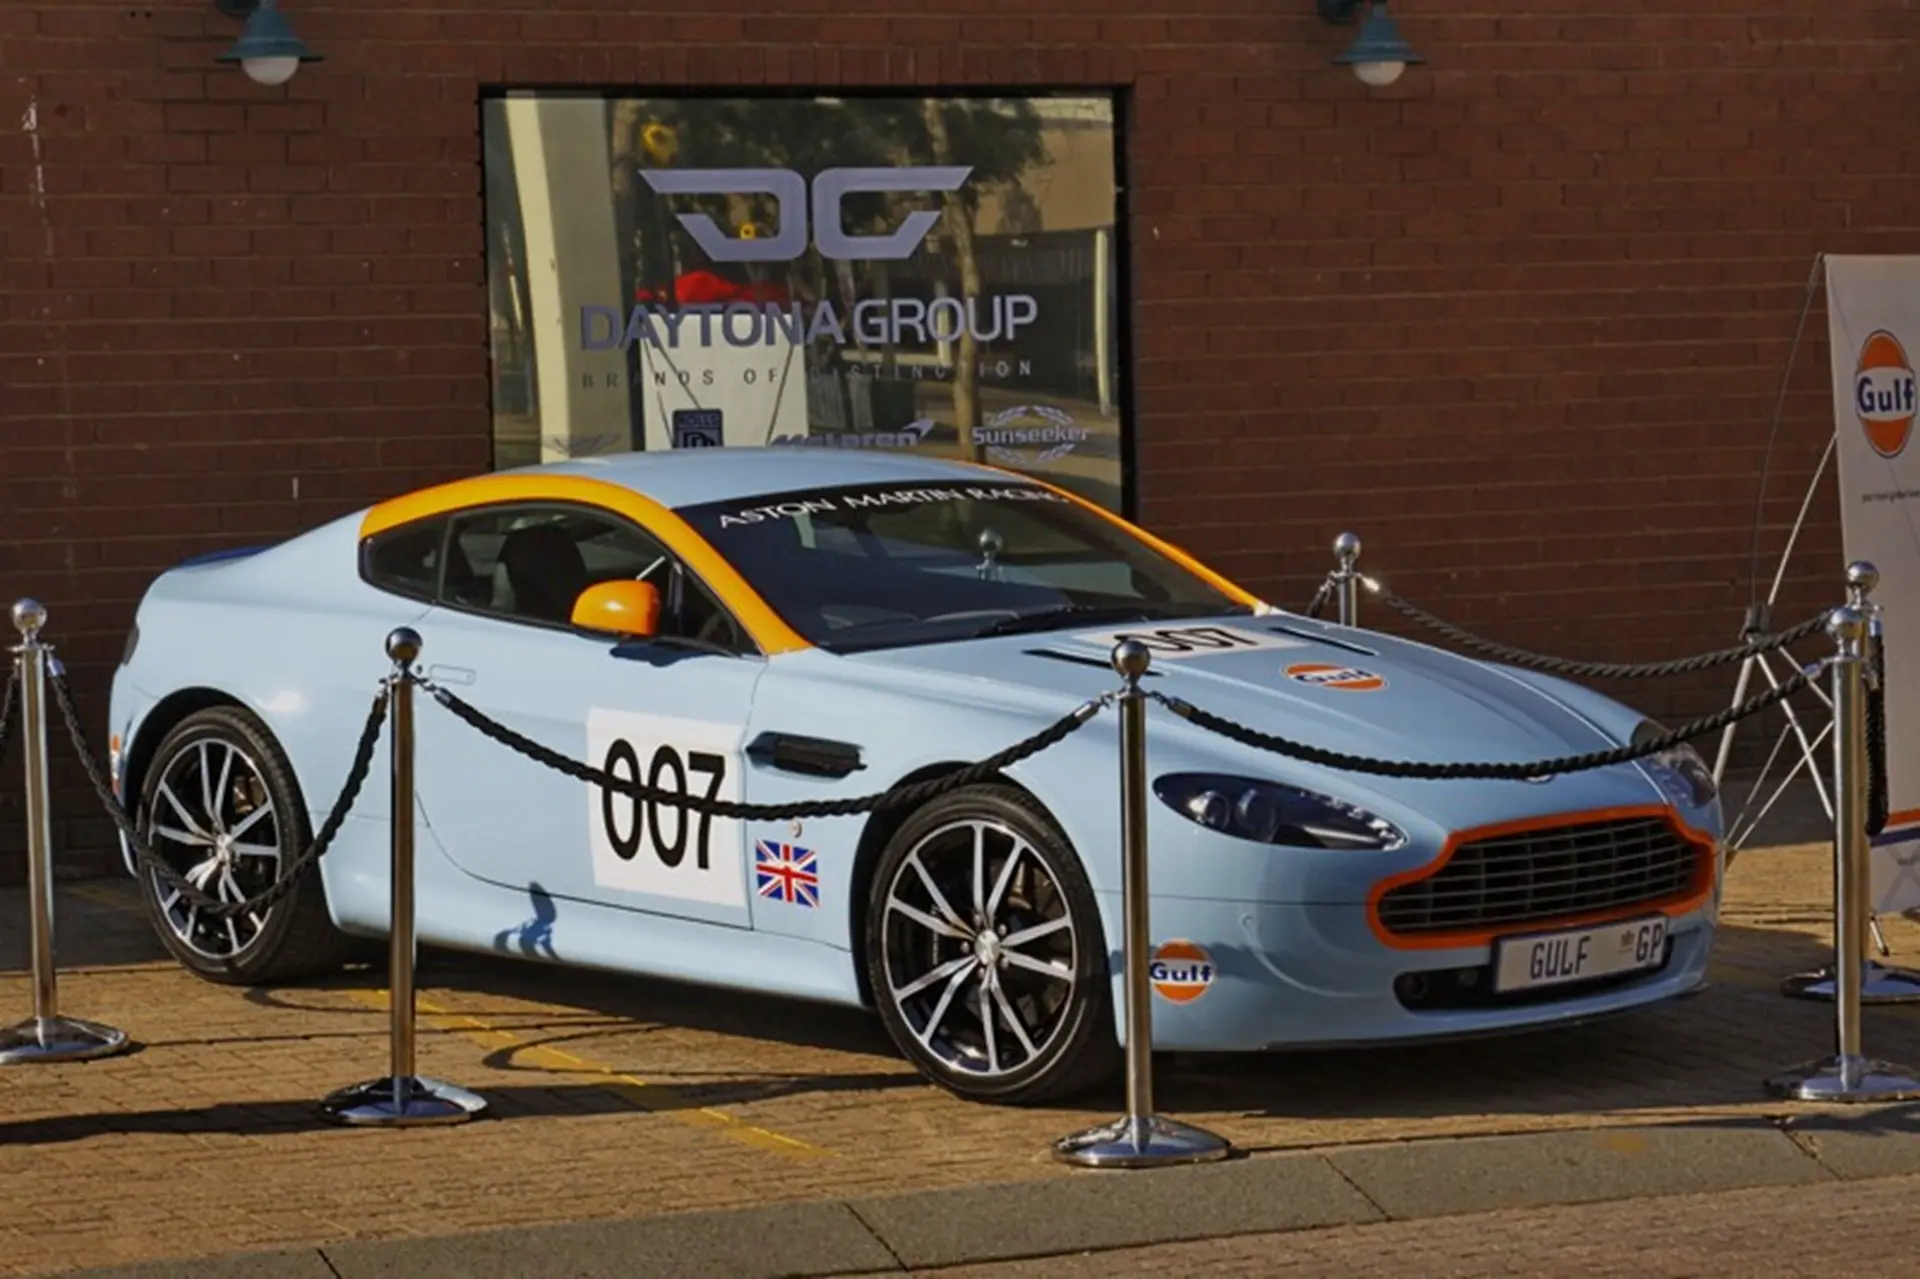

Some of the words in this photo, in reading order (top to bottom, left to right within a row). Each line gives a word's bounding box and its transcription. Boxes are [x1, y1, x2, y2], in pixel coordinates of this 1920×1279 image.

[580, 301, 846, 352] DAYTONA
[853, 295, 1038, 344] GROUP
[743, 367, 780, 386] OF
[1857, 376, 1914, 413] Gulf
[971, 423, 1092, 446] Sunseeker
[719, 497, 838, 529] ASTON
[841, 488, 966, 509] MARTIN
[602, 738, 726, 871] 007
[1530, 935, 1592, 980] GULF
[1635, 923, 1664, 962] GP
[1149, 961, 1212, 982] Gulf
